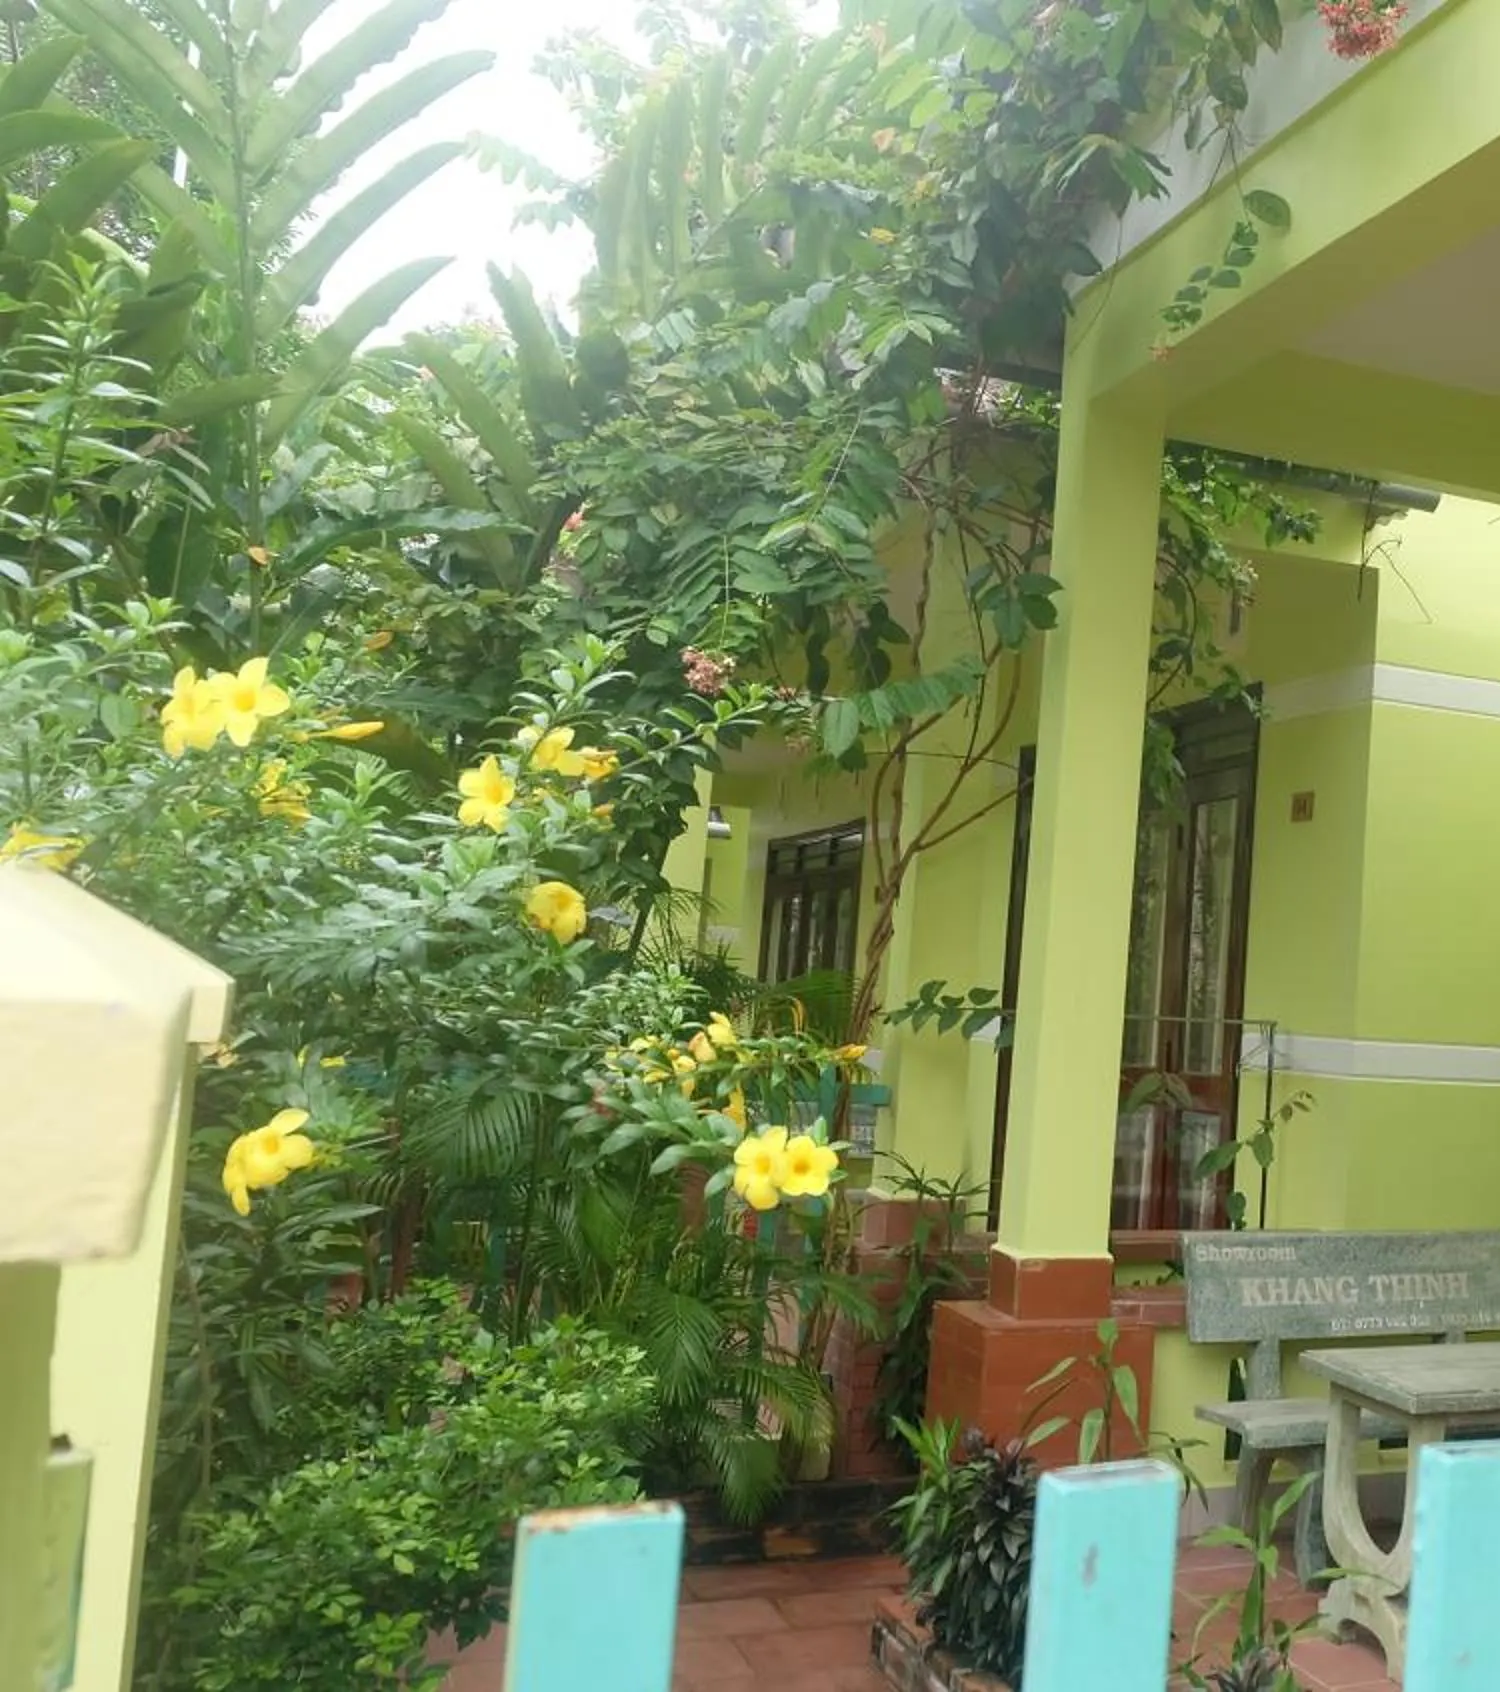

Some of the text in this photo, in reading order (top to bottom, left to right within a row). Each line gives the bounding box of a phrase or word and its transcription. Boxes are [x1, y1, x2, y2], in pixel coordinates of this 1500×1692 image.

[1195, 1244, 1297, 1262] Showroom
[1240, 1272, 1469, 1308] KHANG THỊNH
